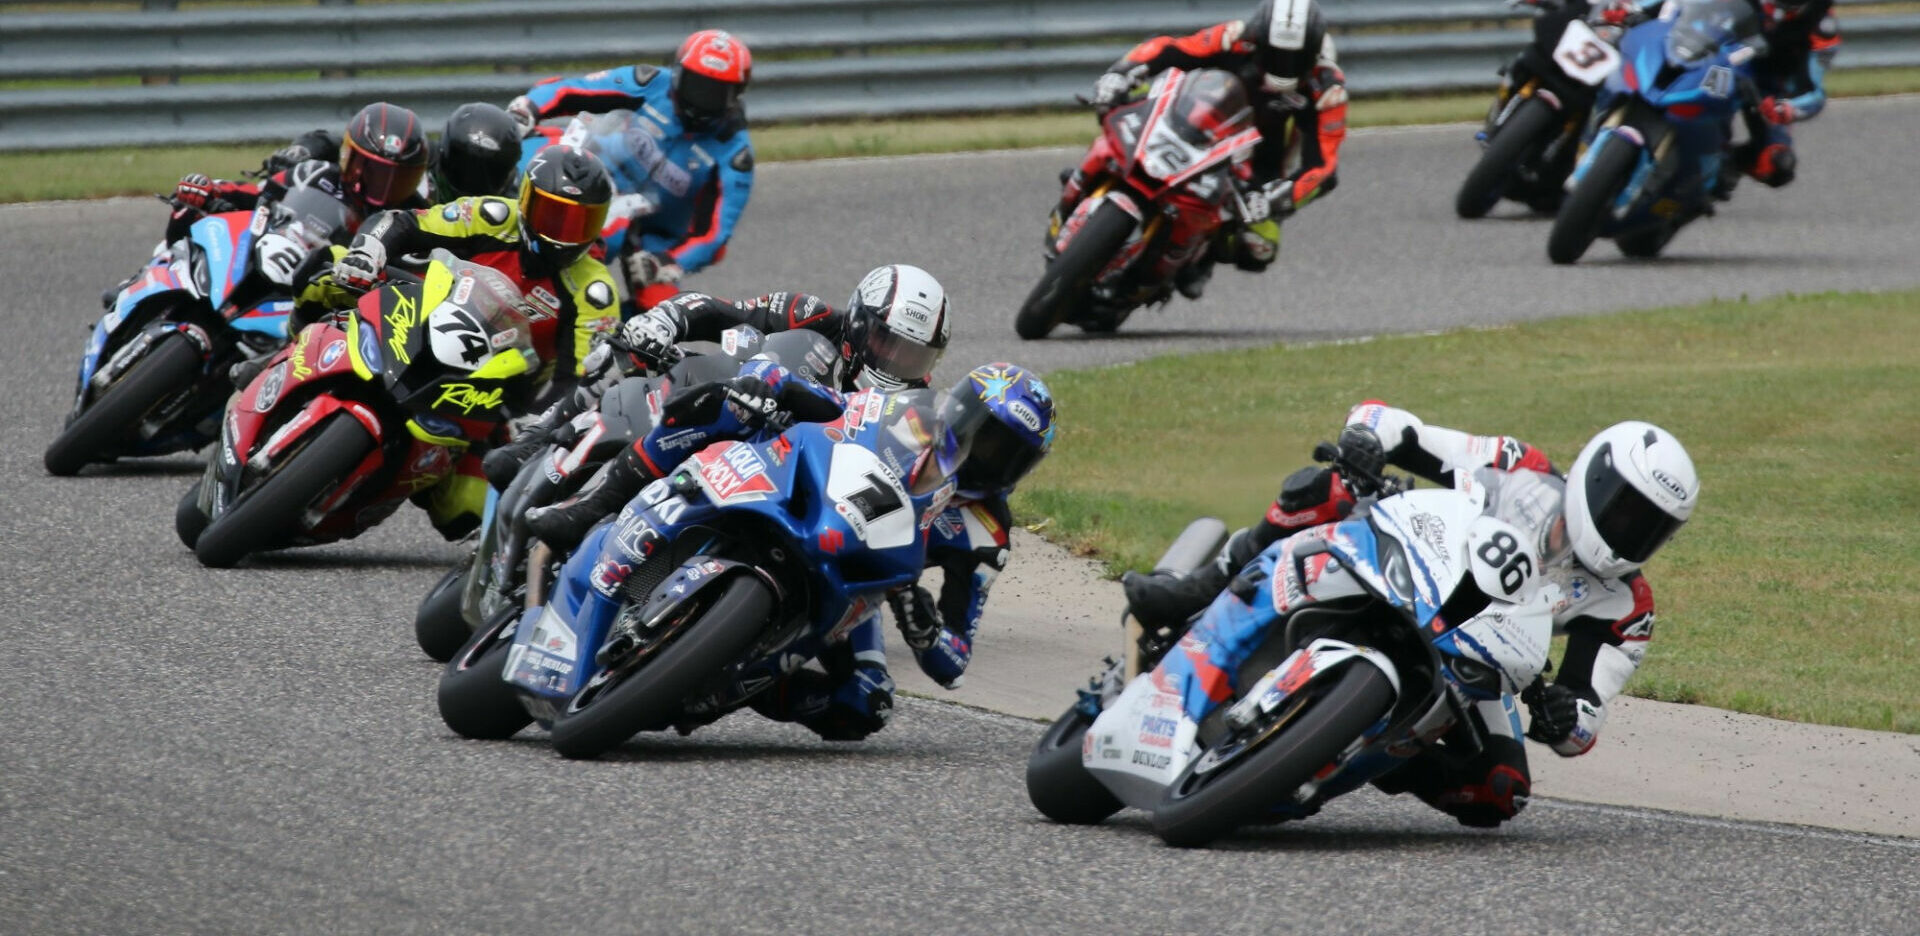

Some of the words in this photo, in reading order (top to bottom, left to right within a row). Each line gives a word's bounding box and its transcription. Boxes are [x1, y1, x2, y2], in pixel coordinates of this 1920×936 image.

[1563, 41, 1609, 69] 3
[384, 285, 416, 365] Royal
[904, 307, 929, 323] SHOEI
[433, 309, 488, 366] 74
[431, 382, 504, 416] Royal
[1013, 401, 1038, 428] SHOEI
[702, 459, 743, 497] MOLY
[723, 441, 768, 481] LIQUI
[861, 471, 906, 524] 1
[1477, 530, 1532, 596] 86
[1141, 715, 1178, 737] PARTS
[1132, 750, 1171, 770] DUNLOP
